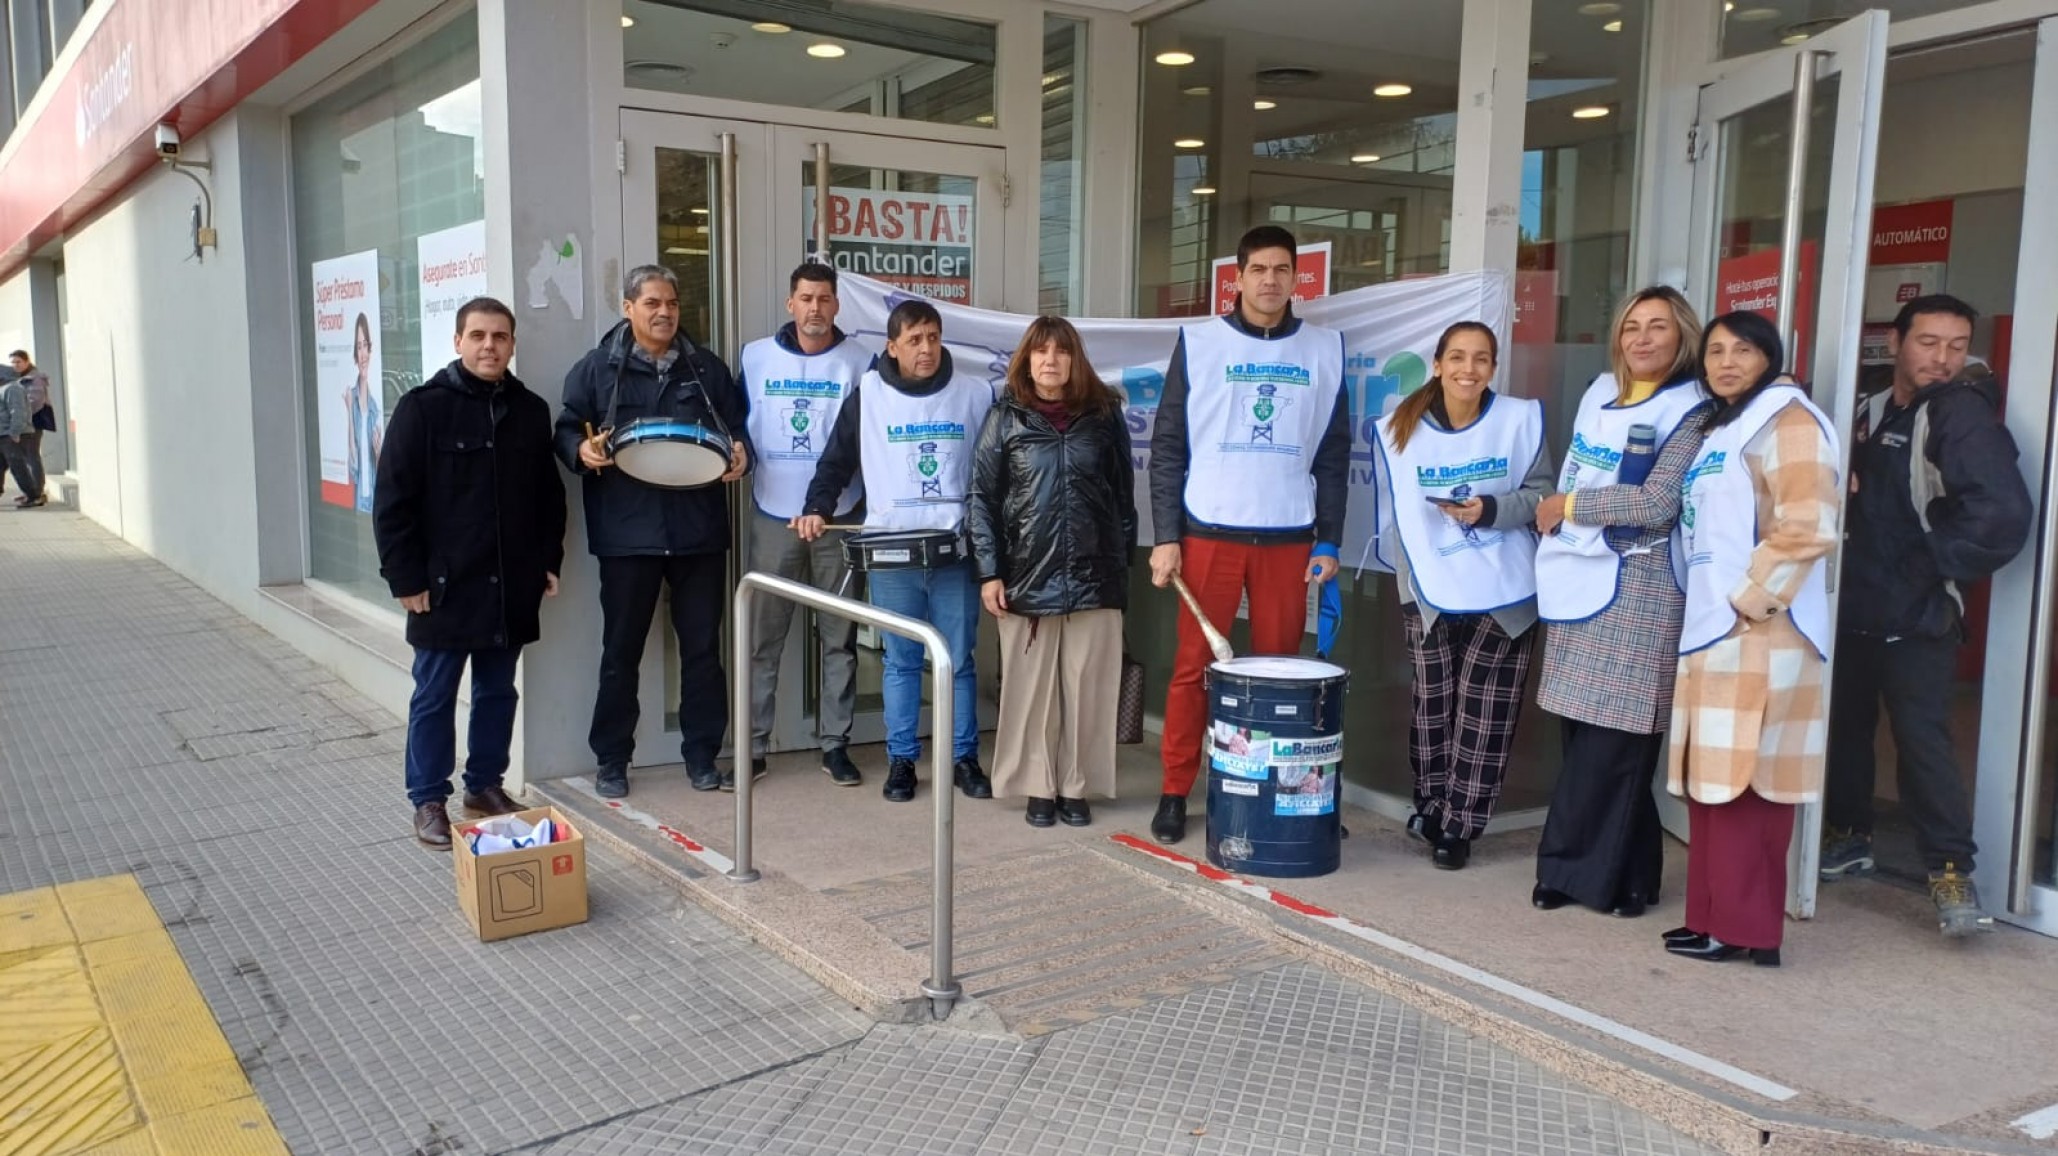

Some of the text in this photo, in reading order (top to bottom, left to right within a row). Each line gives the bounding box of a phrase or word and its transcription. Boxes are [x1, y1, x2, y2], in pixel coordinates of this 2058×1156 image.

[84, 42, 132, 139] Santander
[1874, 226, 1947, 247] AUTOMÁTICO
[423, 252, 487, 288] Asegurate en Sant
[829, 246, 966, 277] antander
[1297, 272, 1317, 286] rtes.
[317, 277, 364, 307] Súper Préstamo
[913, 283, 966, 299] DESPIDOS
[1731, 296, 1766, 312] Santander
[318, 308, 344, 332] Personal
[1226, 363, 1310, 378] La Bancaria
[765, 379, 841, 391] La Bancaria
[887, 422, 964, 435] La Bancaria
[1417, 466, 1436, 478] La
[1439, 457, 1508, 478] Bancaria
